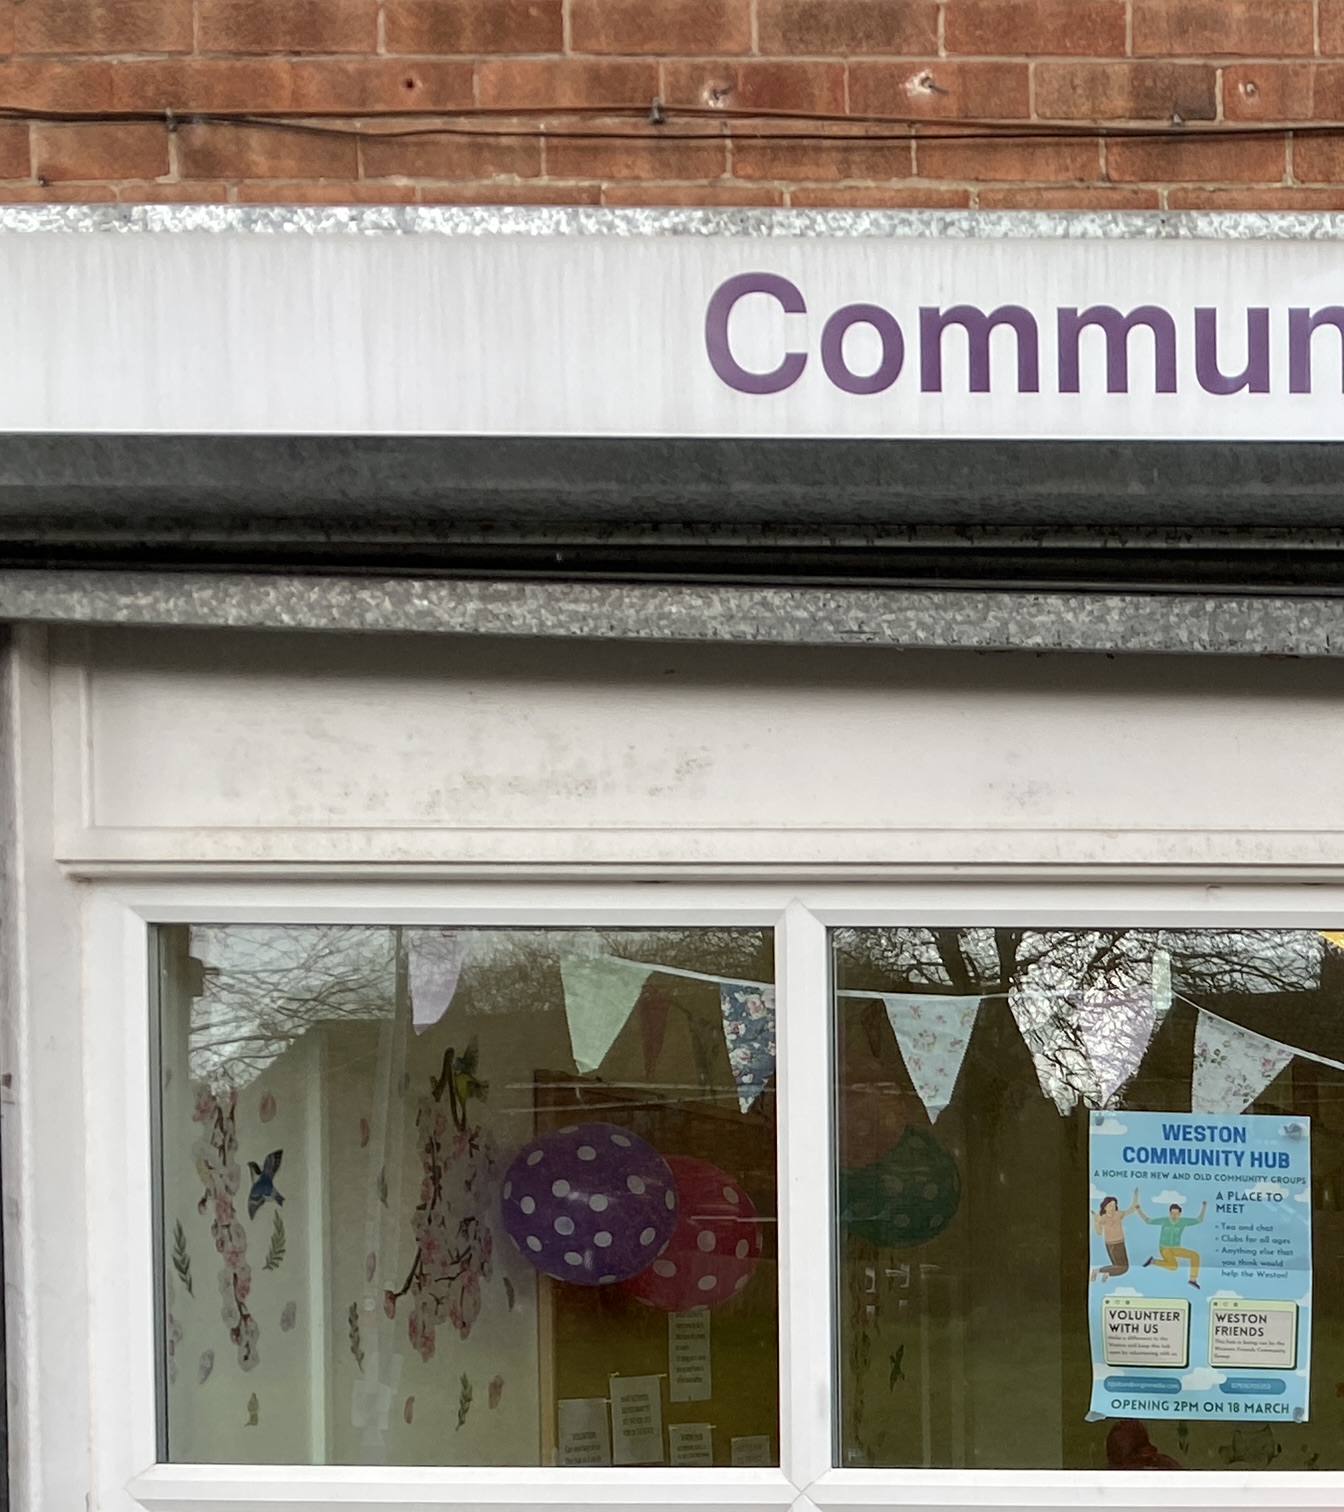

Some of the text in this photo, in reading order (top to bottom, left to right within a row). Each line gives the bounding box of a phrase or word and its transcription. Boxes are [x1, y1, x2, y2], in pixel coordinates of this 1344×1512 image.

[1162, 1124, 1246, 1143] WESTON
[1122, 1146, 1290, 1169] COMMUNITY HUB
[1102, 1170, 1128, 1179] HOME
[1131, 1170, 1148, 1179] FOR
[1150, 1171, 1170, 1180] NEW
[1172, 1172, 1191, 1181] AND
[1193, 1173, 1212, 1181] OLD
[1214, 1174, 1268, 1183] COMMUNITY
[1270, 1176, 1306, 1184] GROUPS
[1216, 1191, 1283, 1202] A PLACE TO
[1216, 1204, 1245, 1213] MEET
[1221, 1234, 1243, 1242] Clubs
[1246, 1235, 1257, 1243] for
[1221, 1247, 1257, 1256] Anything
[1109, 1310, 1180, 1321] VOLUNTEER
[1216, 1313, 1267, 1323] WESTON
[1109, 1323, 1158, 1334] WITH US
[1215, 1326, 1264, 1337] FRIENDS
[1111, 1399, 1289, 1414] OPENING 2PM ON 18 MARCH
